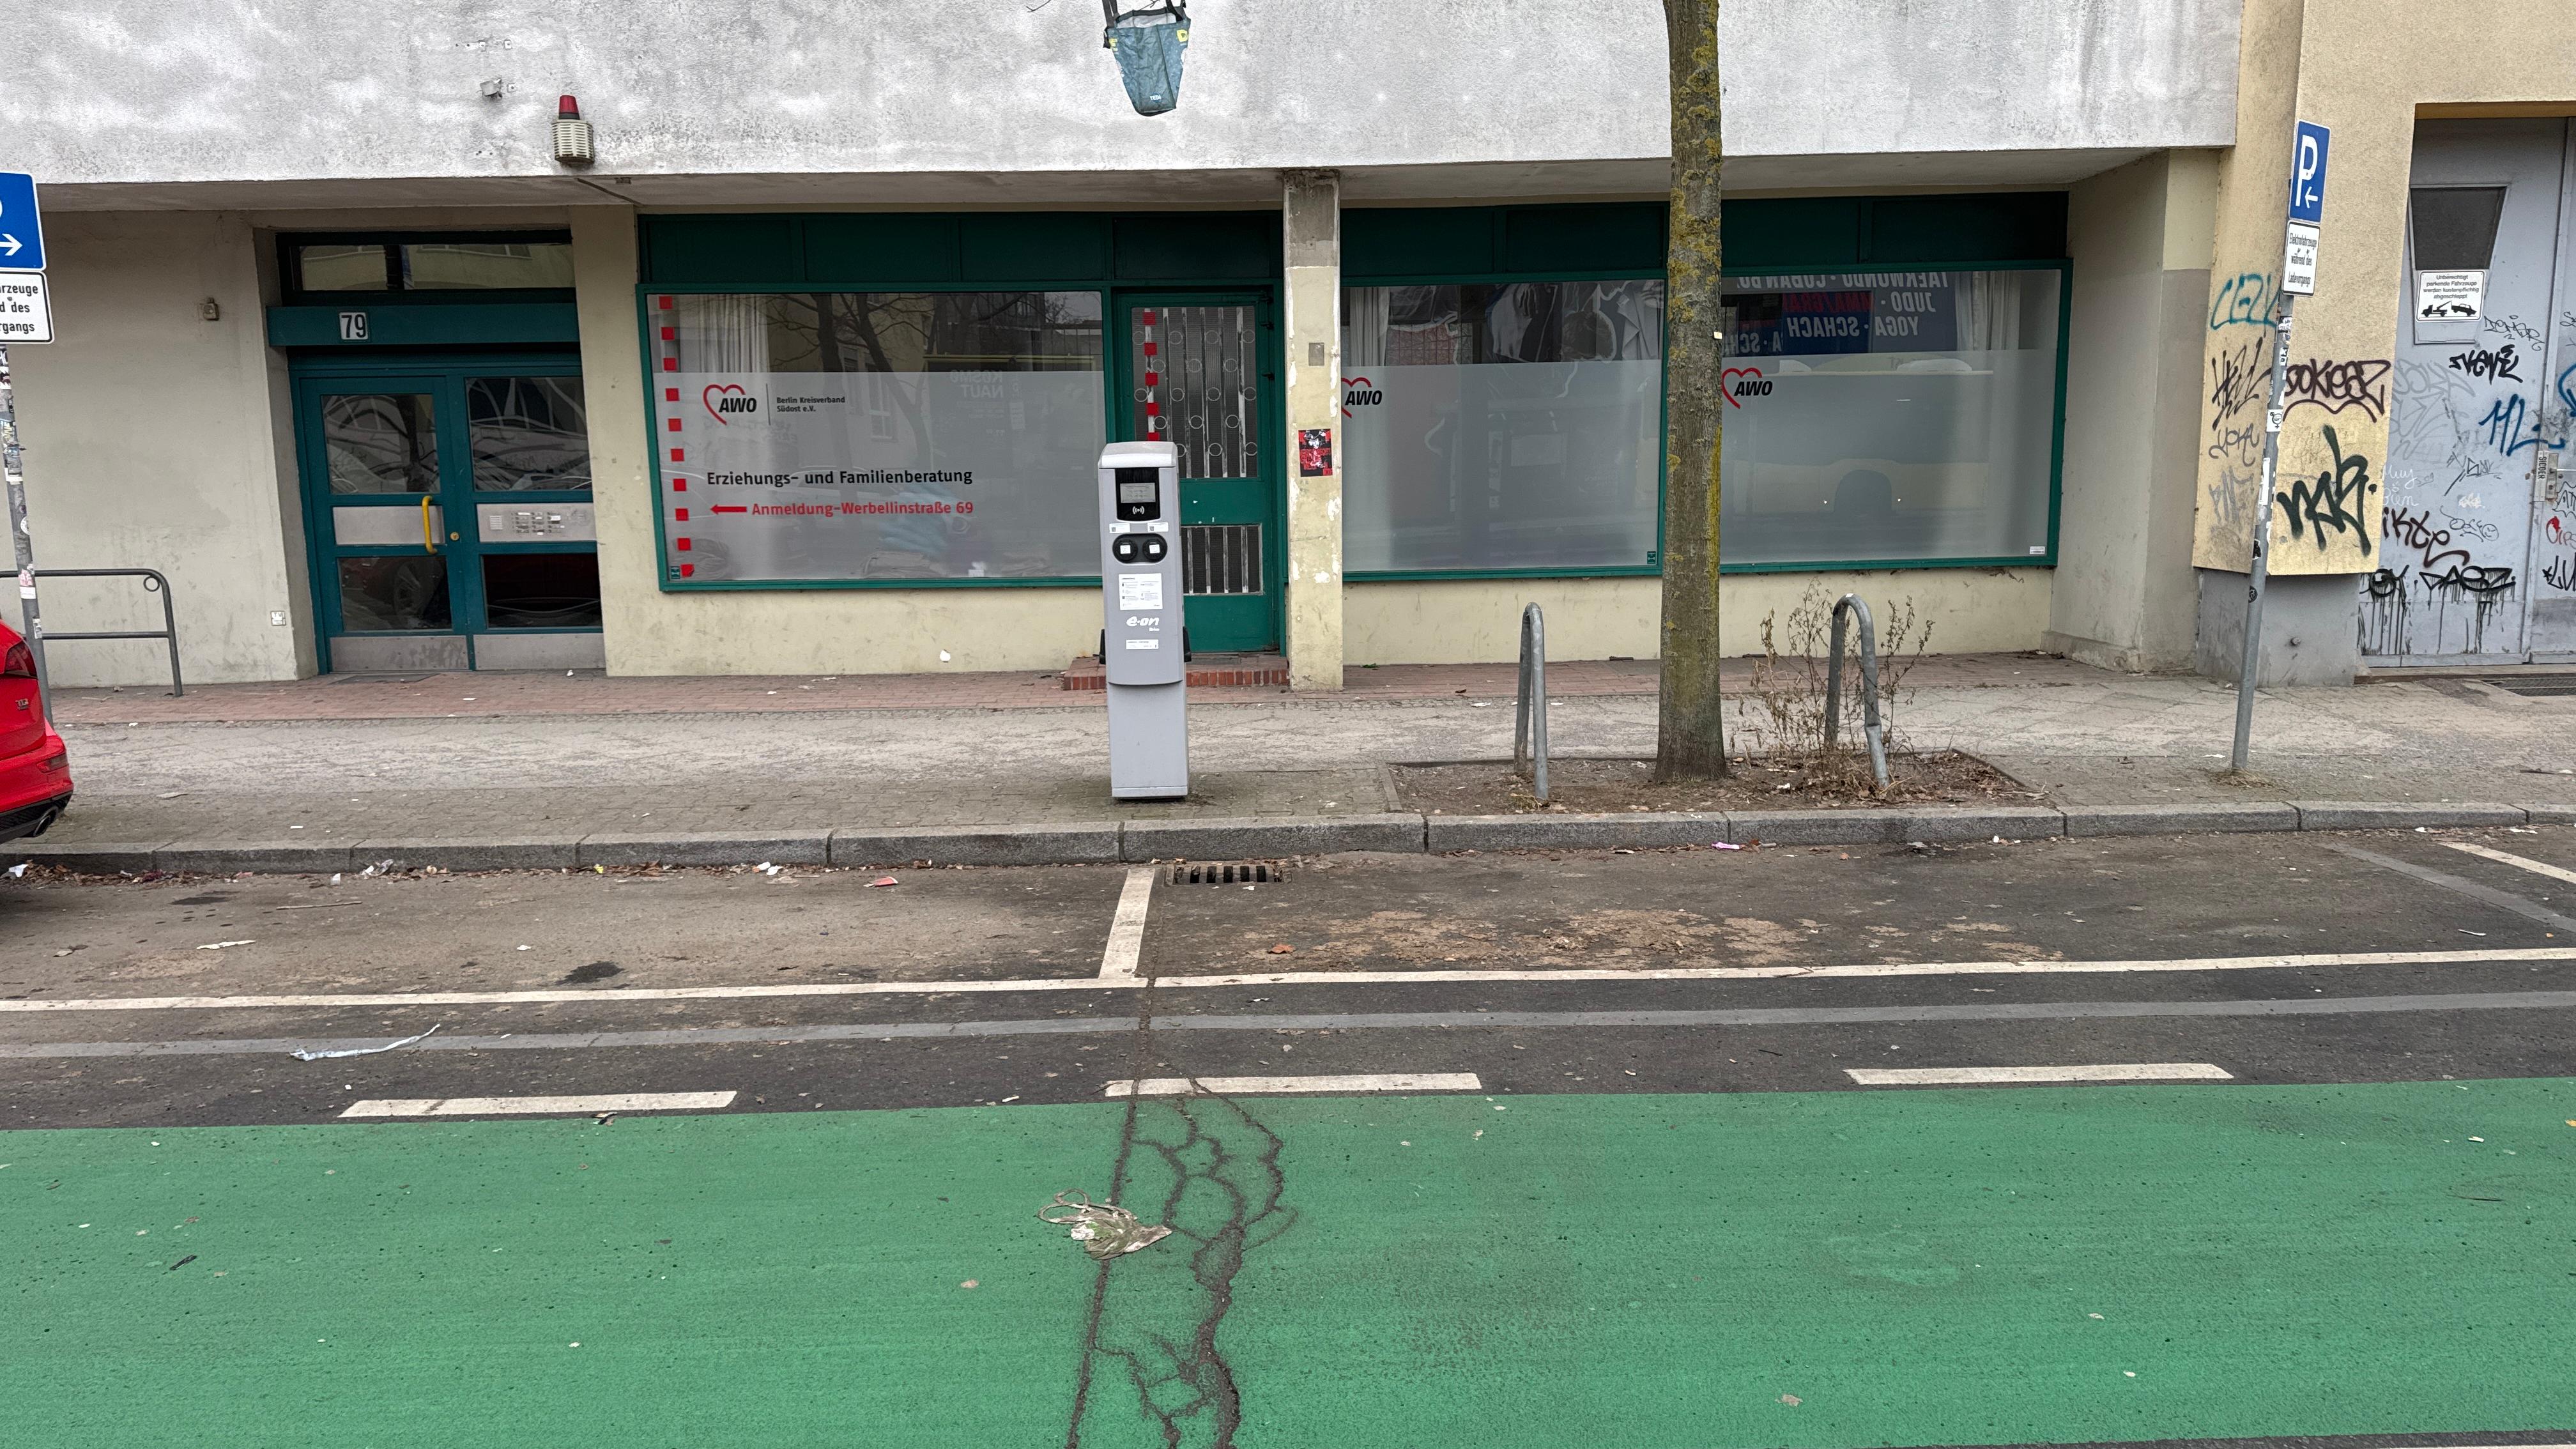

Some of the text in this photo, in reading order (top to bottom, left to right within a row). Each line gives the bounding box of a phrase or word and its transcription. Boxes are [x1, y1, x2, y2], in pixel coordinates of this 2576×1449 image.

[2296, 134, 2318, 207] P
[11, 302, 30, 312] des
[341, 314, 366, 338] 79
[1733, 380, 1773, 396] AWO
[719, 397, 757, 413] AWO
[1345, 390, 1383, 406] AWO
[707, 470, 973, 487] Erziehungs- und Familienberatung
[752, 502, 973, 517] Anmeldung-Werbellinstraße 69
